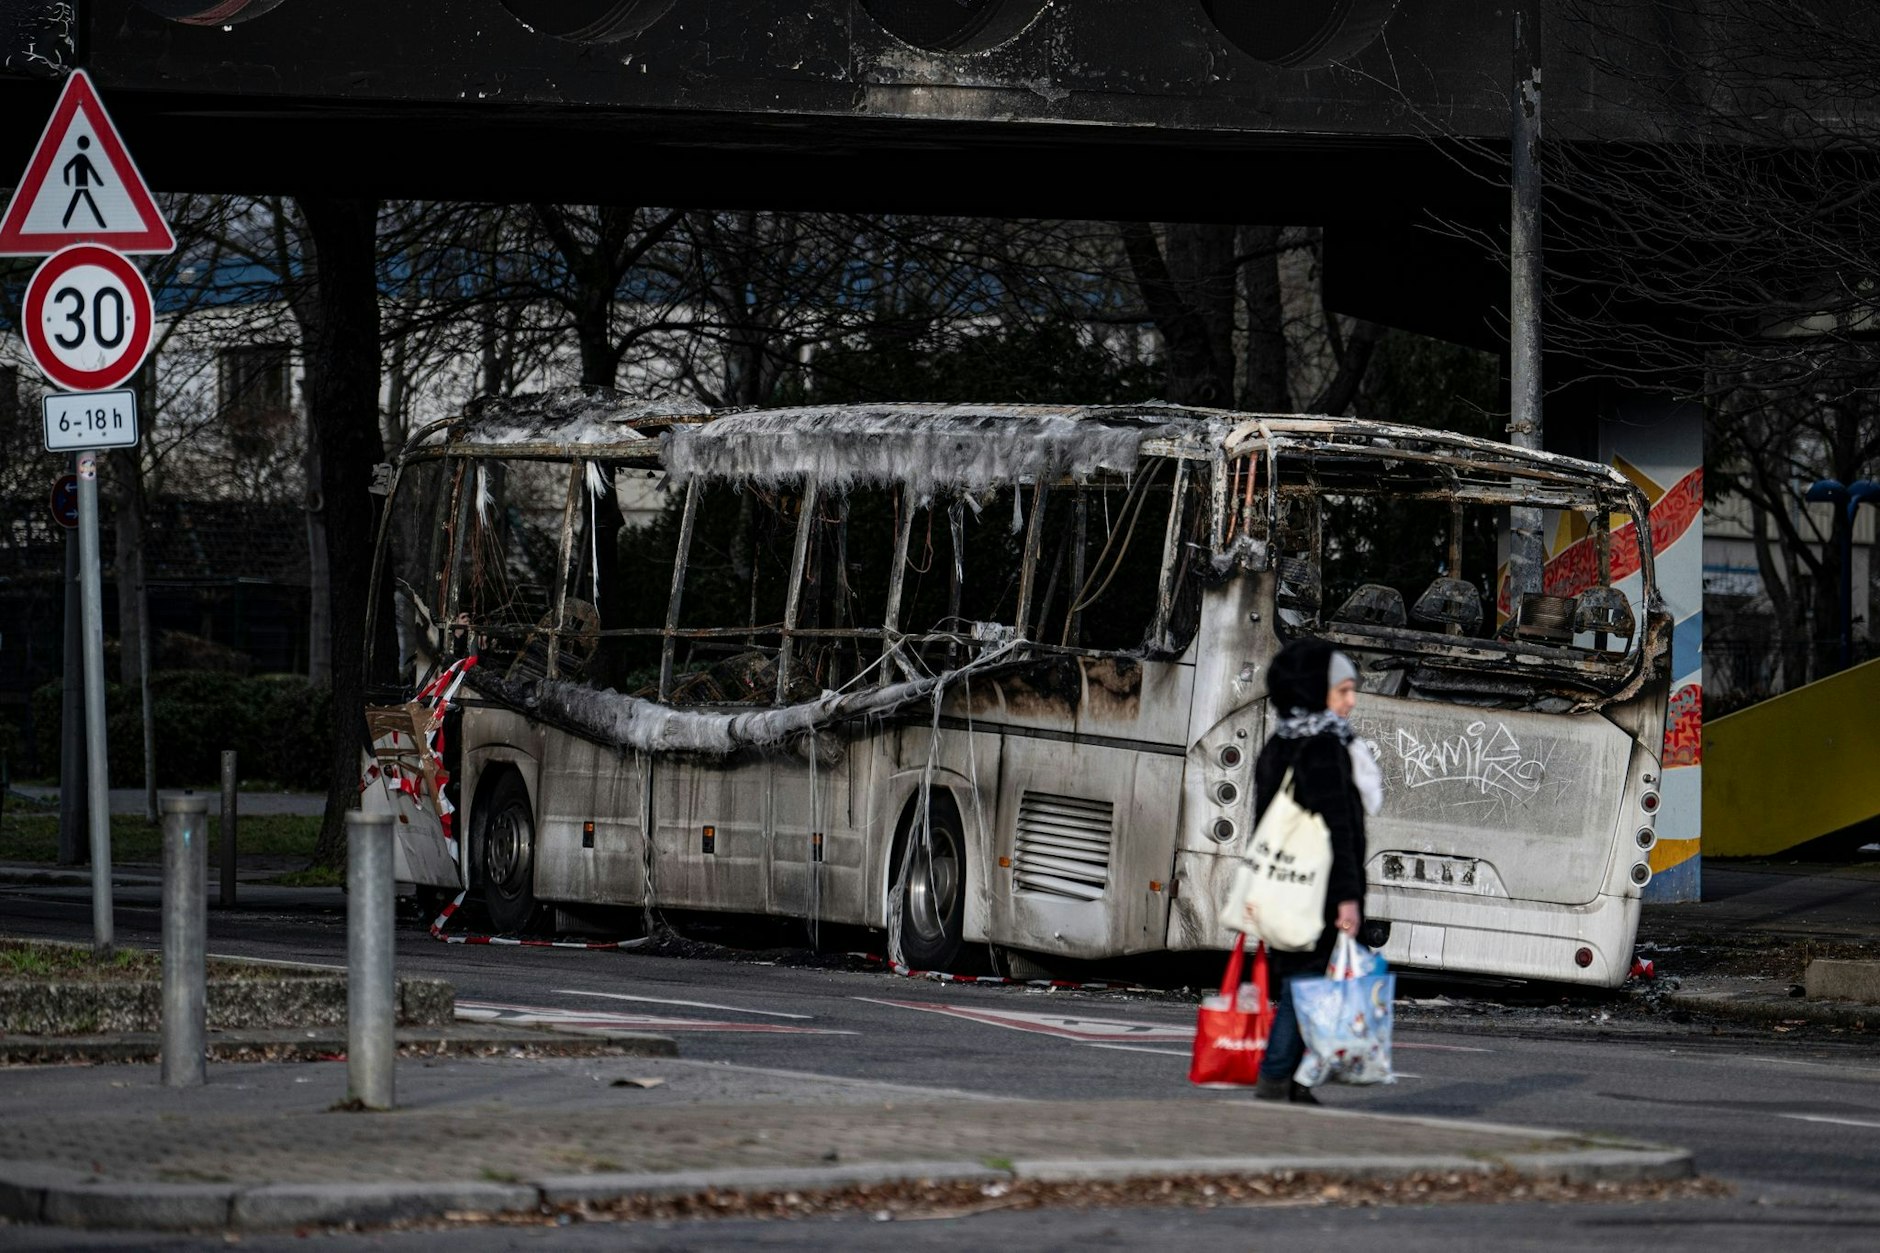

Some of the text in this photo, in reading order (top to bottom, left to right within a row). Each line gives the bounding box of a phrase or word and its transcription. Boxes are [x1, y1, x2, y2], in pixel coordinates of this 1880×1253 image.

[54, 287, 124, 349] 30
[59, 408, 122, 432] 6-18 h
